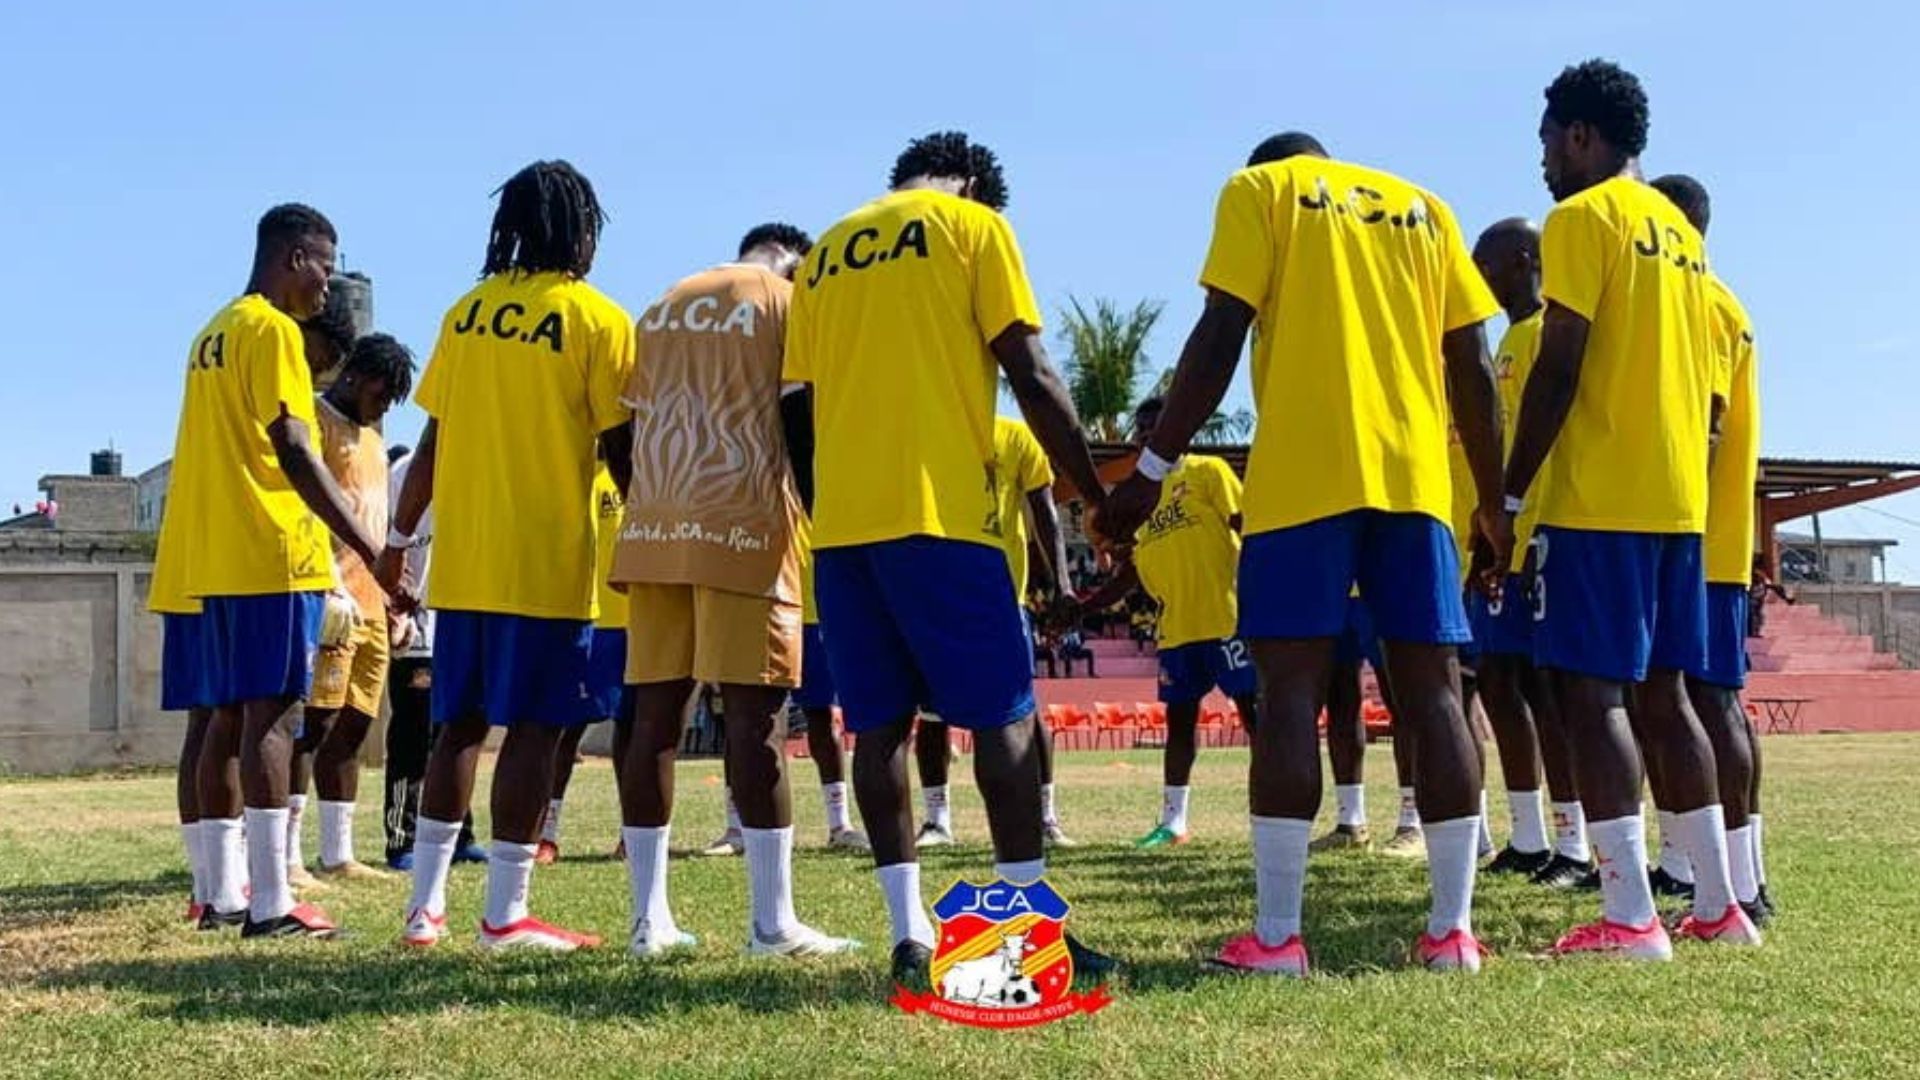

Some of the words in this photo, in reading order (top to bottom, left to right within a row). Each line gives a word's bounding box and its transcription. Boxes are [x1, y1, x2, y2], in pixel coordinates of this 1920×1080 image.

[807, 219, 929, 289] J.C.A
[1635, 216, 1706, 275] J.C.
[455, 299, 563, 354] J.C.A
[645, 296, 755, 338] J.C.A
[670, 522, 703, 541] JCA
[1221, 640, 1249, 671] 12
